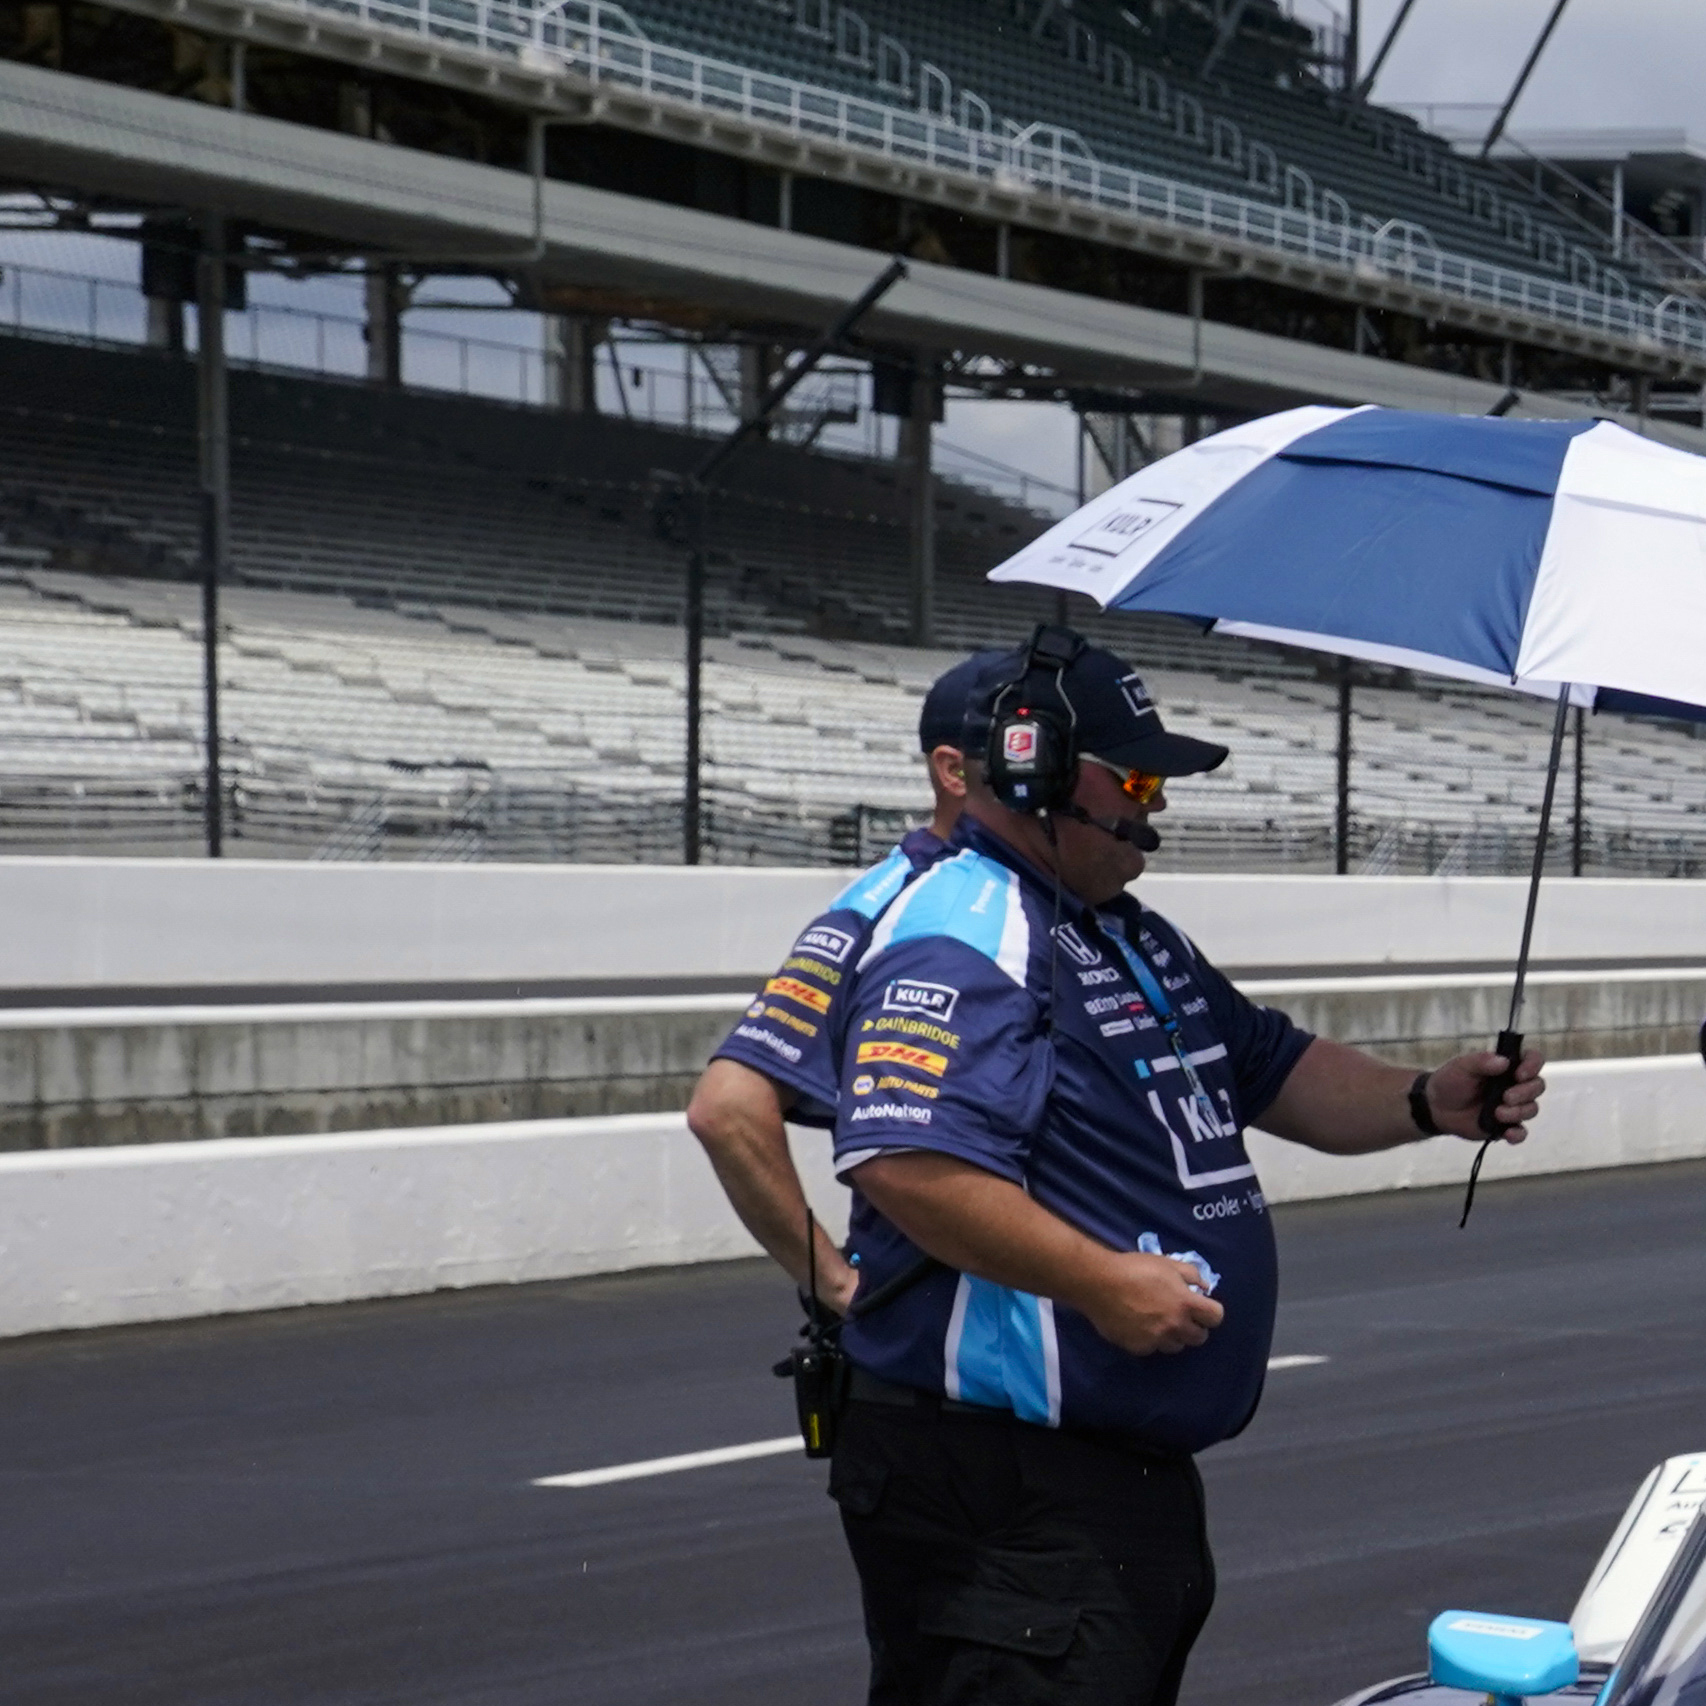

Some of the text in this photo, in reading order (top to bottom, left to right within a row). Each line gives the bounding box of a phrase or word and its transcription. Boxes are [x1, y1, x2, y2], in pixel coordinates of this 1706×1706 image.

[804, 931, 842, 951] KULR
[775, 981, 820, 1004] DHL
[896, 989, 946, 1007] KULR
[876, 1018, 960, 1048] GAINBRIDGE
[869, 1046, 930, 1067] DHL
[851, 1104, 931, 1124] AutoNation
[1194, 1195, 1242, 1221] cooler
